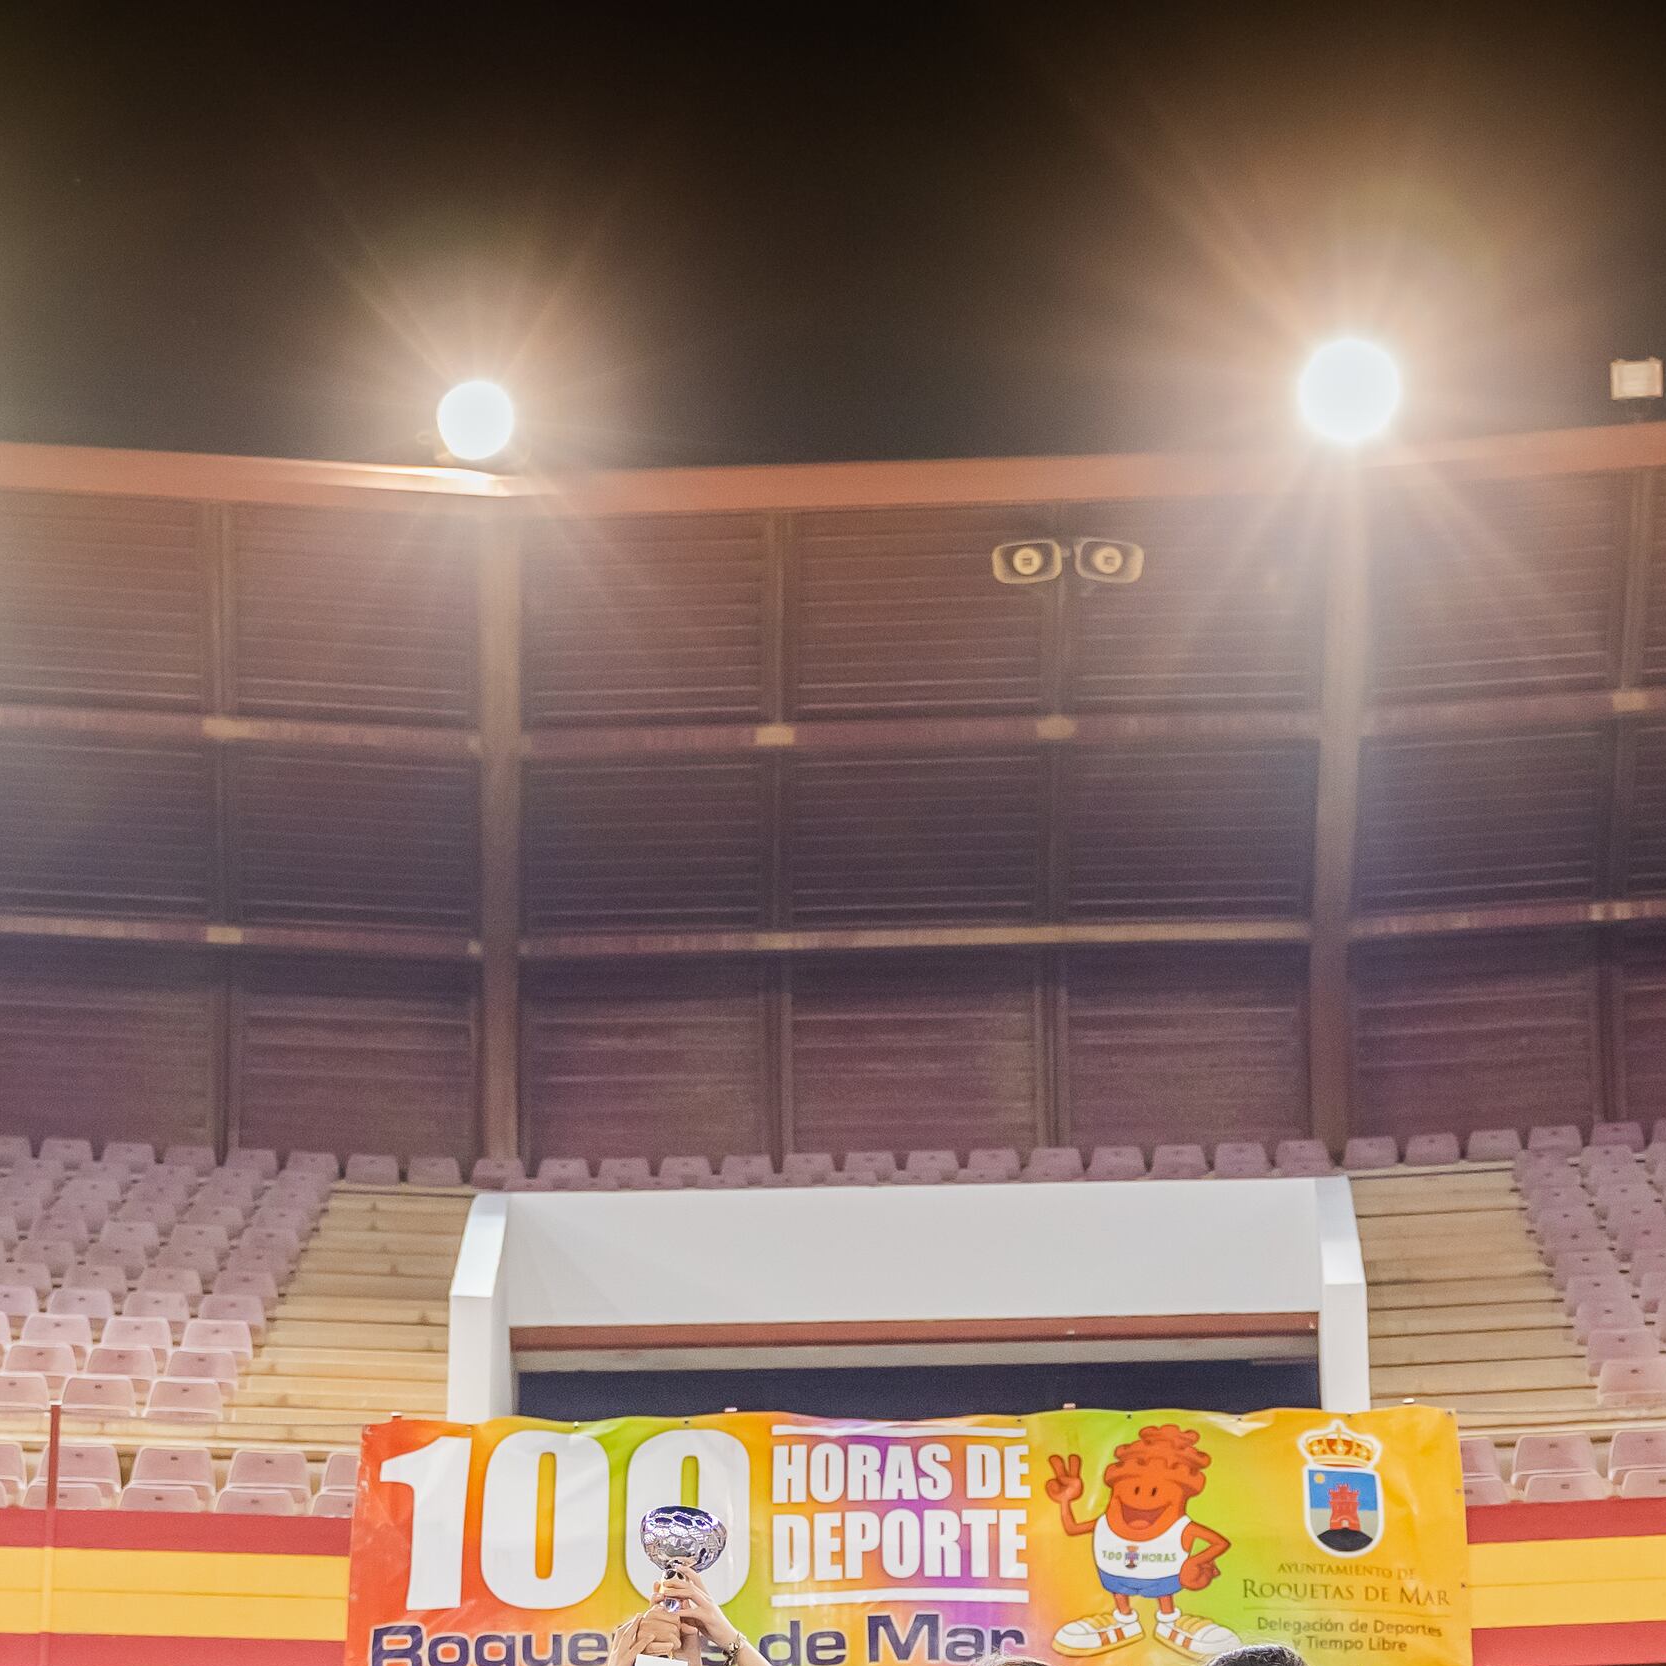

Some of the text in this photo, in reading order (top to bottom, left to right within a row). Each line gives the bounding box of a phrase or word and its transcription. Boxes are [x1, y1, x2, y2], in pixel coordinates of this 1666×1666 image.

[771, 1443, 1032, 1504] HORAS DE
[379, 1429, 751, 1611] 100
[772, 1508, 1030, 1584] DEPORTE
[1277, 1562, 1417, 1581] AYUNTAMIENTO DE
[1242, 1578, 1451, 1607] ROQUETAS DE MAR
[866, 1612, 1027, 1664] Mar
[1257, 1616, 1443, 1638] Delegación de Deportes
[1306, 1634, 1365, 1653] Tiempo
[1368, 1636, 1408, 1653] Libre
